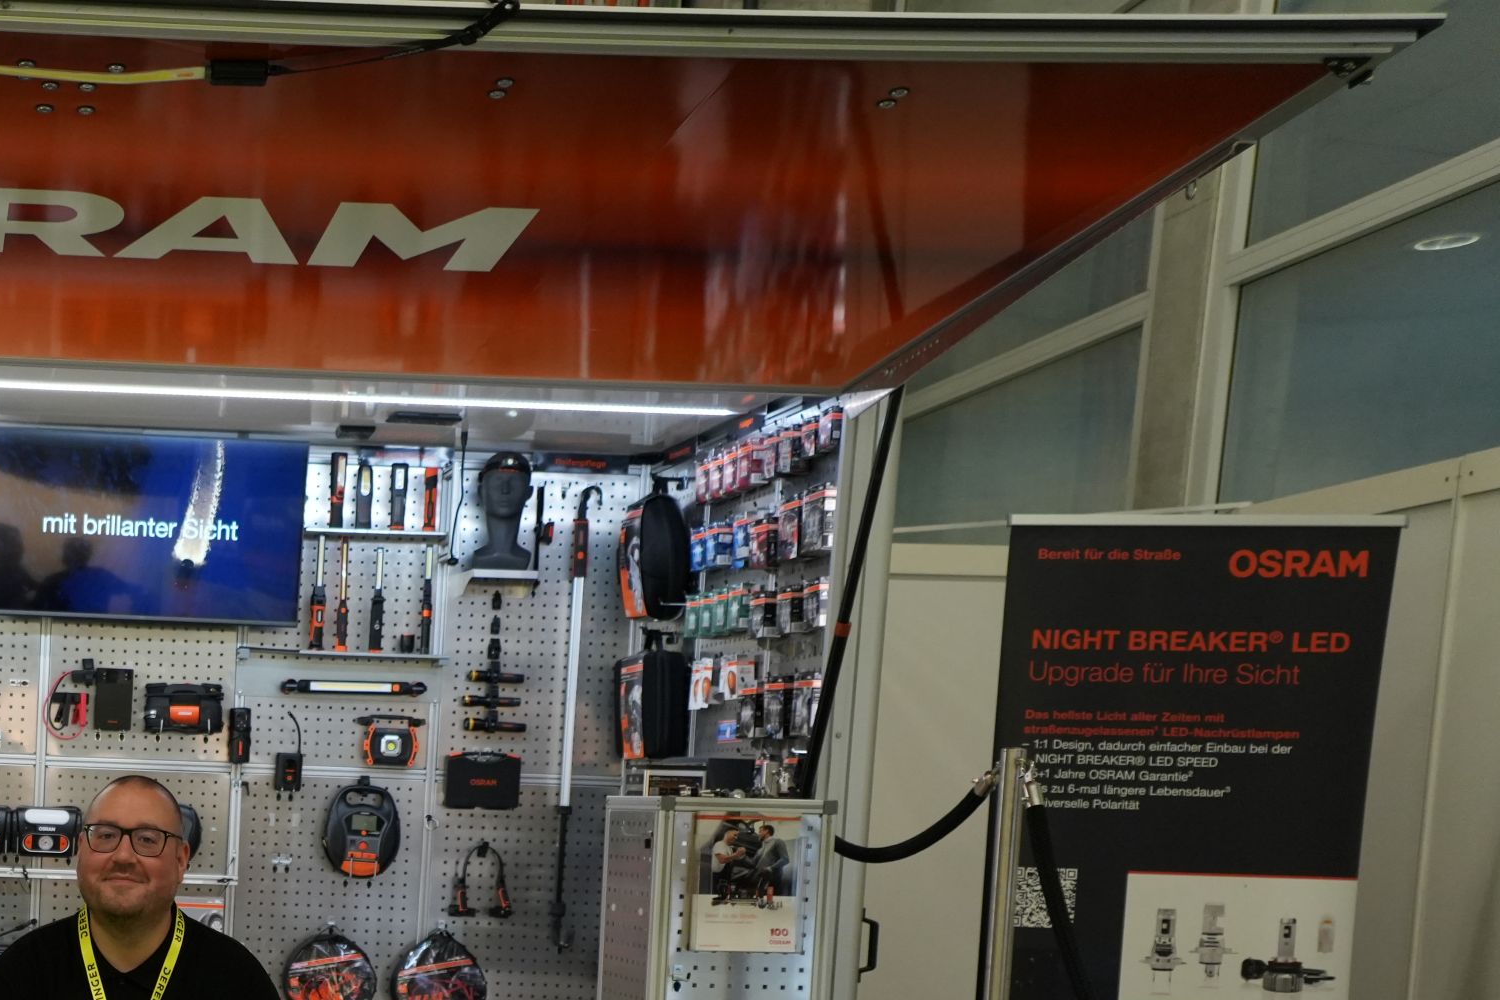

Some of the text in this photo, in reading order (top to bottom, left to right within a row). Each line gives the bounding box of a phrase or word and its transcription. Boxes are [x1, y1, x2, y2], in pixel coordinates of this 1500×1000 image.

[42, 513, 239, 542] mit brillanter Sicht
[1038, 548, 1182, 561] Bereit für die Straße
[1228, 549, 1370, 579] OSRAM
[1032, 629, 1121, 650] NIGHT
[1292, 632, 1350, 653] LED
[1029, 660, 1300, 687] Upgrade für Ihre Sicht
[1025, 709, 1225, 723] Das hellste Licht aller Zeiten mit
[1034, 739, 1292, 754] 1:1 Design, dadurch einfacher Einbau bei der
[1035, 754, 1074, 764] NIGHT
[1149, 756, 1174, 767] LED
[1177, 756, 1218, 768] SPEED
[1054, 769, 1086, 779] Jahre
[1089, 769, 1135, 780] OSRAM
[1051, 784, 1064, 793] zu
[1067, 784, 1100, 795] 6-mal
[1103, 785, 1146, 797] längere
[1092, 798, 1140, 810] Polarität
